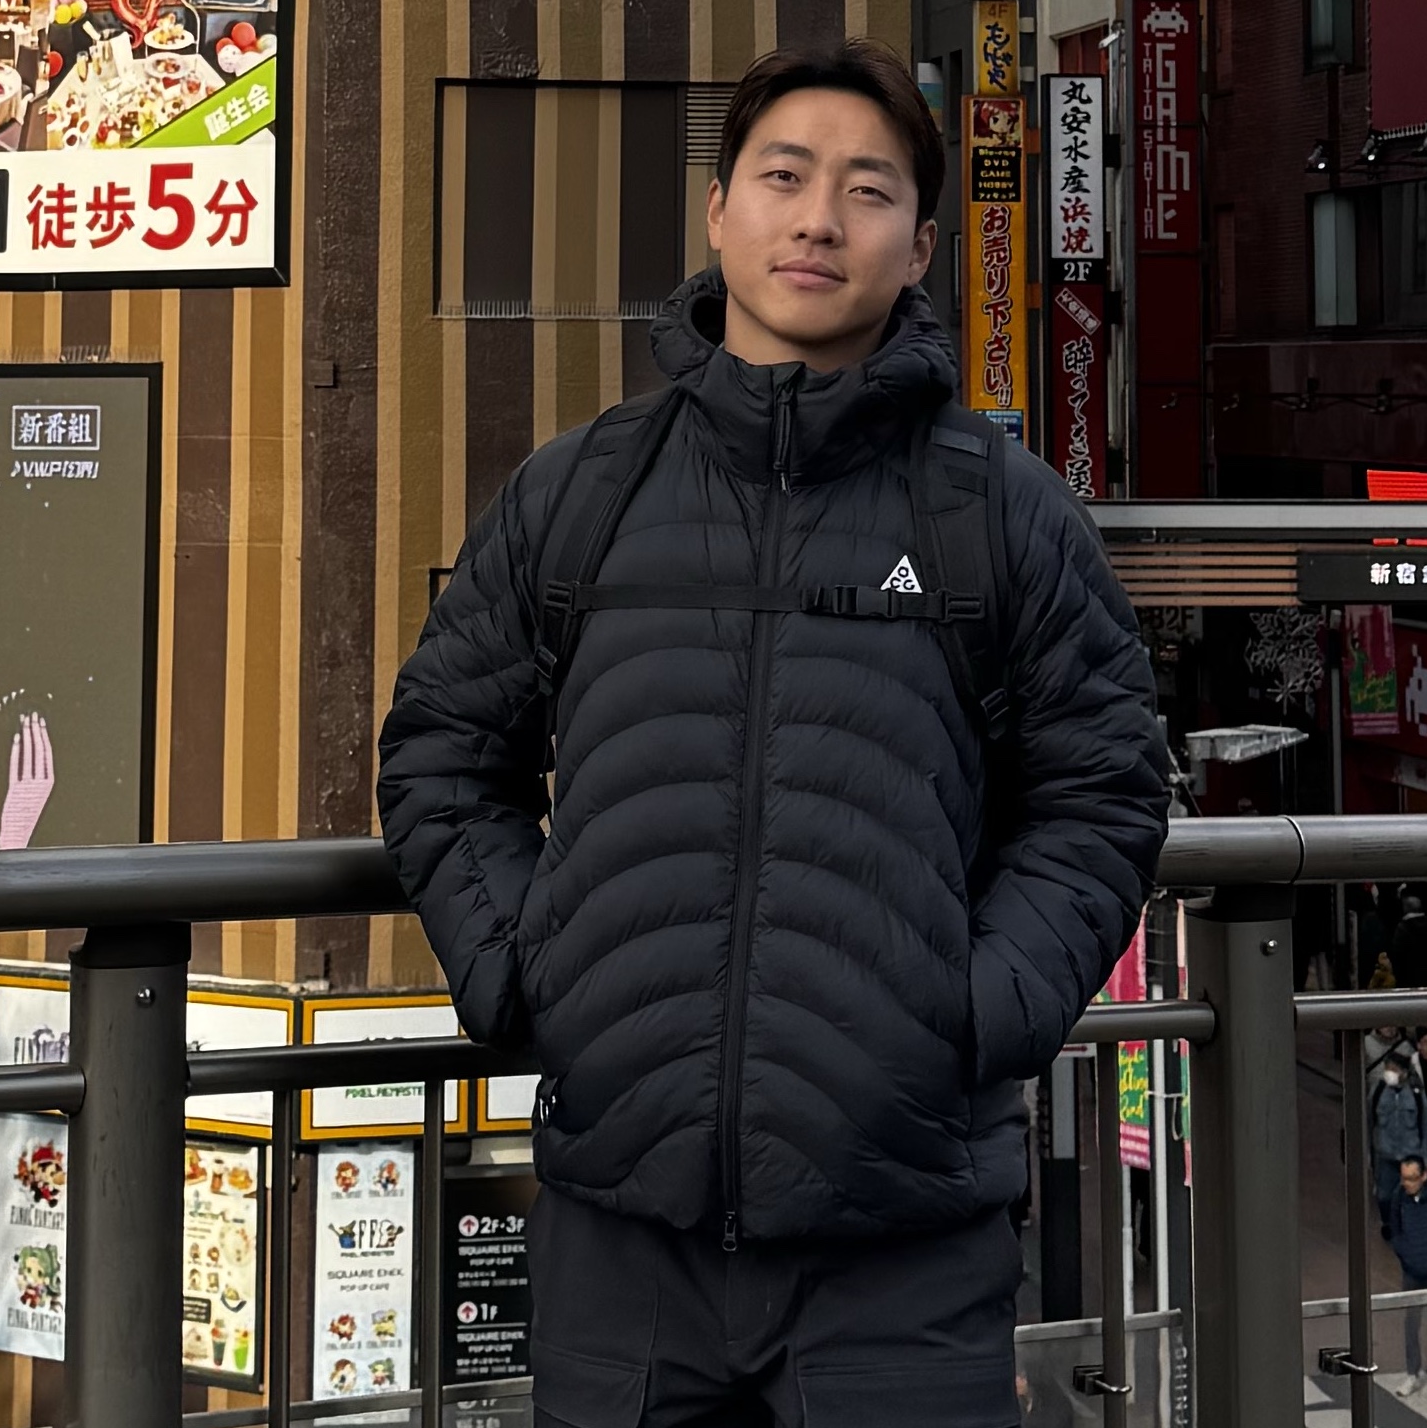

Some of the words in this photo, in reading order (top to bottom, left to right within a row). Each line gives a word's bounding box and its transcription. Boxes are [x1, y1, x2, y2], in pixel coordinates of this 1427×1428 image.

[1143, 42, 1153, 121] TAITO
[204, 82, 271, 143] 誕生会
[983, 159, 1009, 169] DVD
[1156, 42, 1190, 241] GAME
[980, 169, 1012, 180] GAME
[1143, 129, 1154, 240] STATION
[26, 162, 259, 251] 徒歩5分
[1063, 262, 1092, 282] 2F
[19, 411, 93, 445] 新番組
[480, 1303, 499, 1321] 1F
